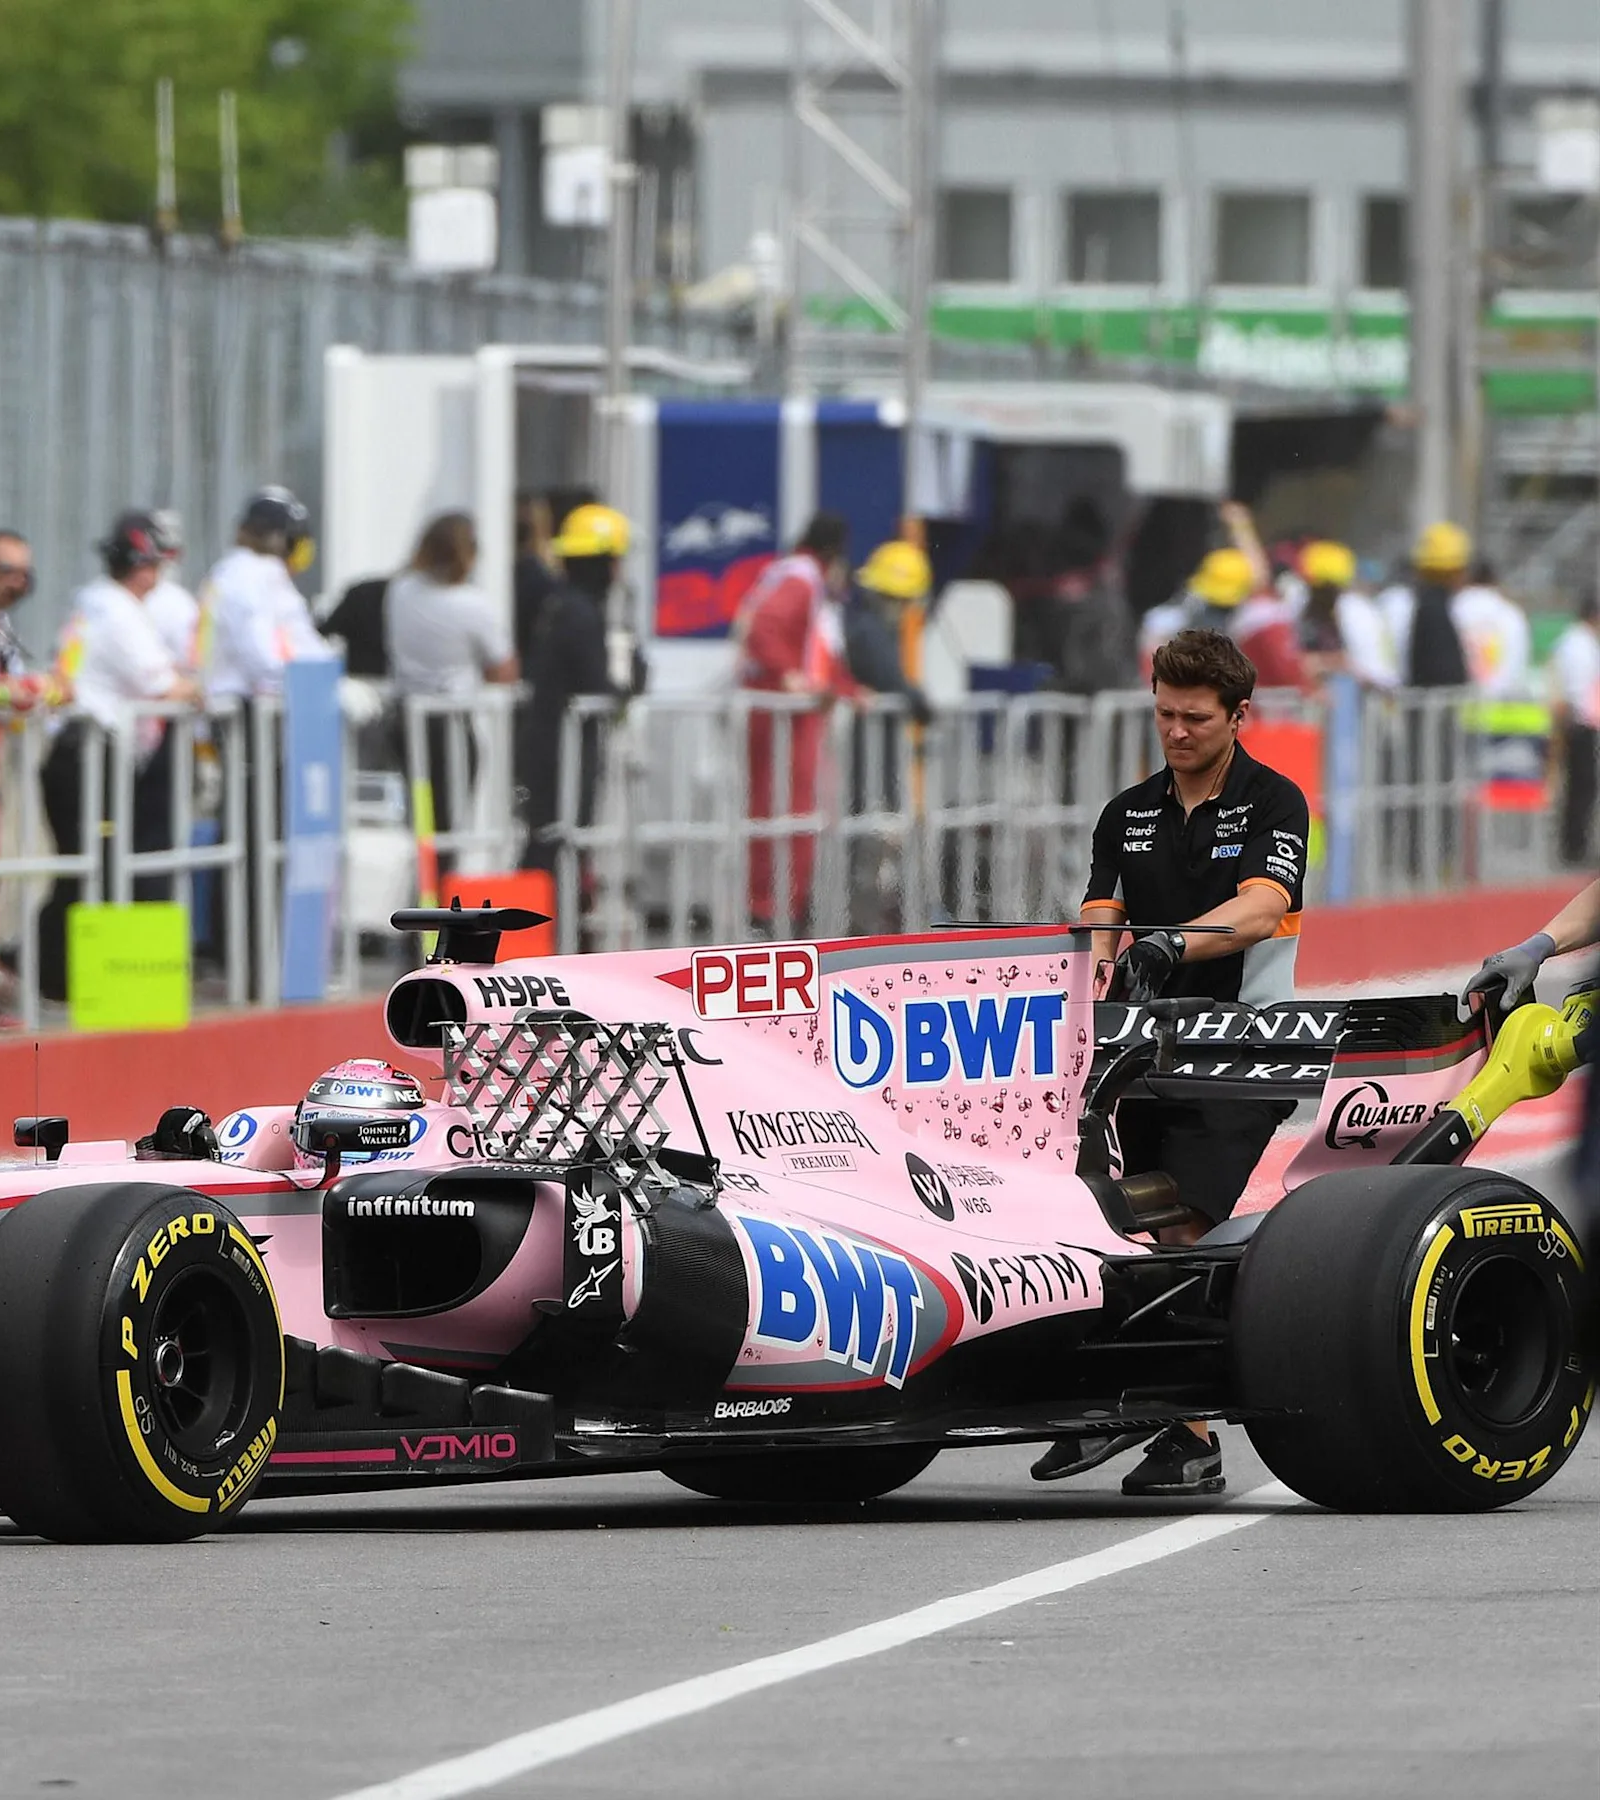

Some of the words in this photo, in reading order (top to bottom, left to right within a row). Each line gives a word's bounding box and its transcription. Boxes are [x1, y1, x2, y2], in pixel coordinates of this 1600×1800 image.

[1126, 823, 1157, 837] Claro
[1123, 841, 1153, 853] NEC
[473, 975, 571, 1008] HYPE
[695, 950, 814, 1016] PER
[905, 990, 1064, 1085] BWT
[309, 1082, 325, 1094] EC
[345, 1085, 384, 1097] BWT
[393, 1089, 422, 1103] NEC
[1346, 1103, 1427, 1128] QUAKER
[358, 1125, 398, 1137] JOHNNIE
[360, 1135, 398, 1145] WALKER
[726, 1109, 881, 1160] KINGFISHER
[790, 1154, 851, 1171] PREMIUM
[347, 1194, 476, 1219] infinitum
[959, 1196, 992, 1214] W66
[1459, 1202, 1546, 1239] PIRELLI
[1537, 1228, 1568, 1260] SP
[121, 1315, 138, 1361] P
[130, 1212, 216, 1304] ZERO
[988, 1251, 1090, 1308] FXTM
[737, 1214, 920, 1381] BWT
[714, 1397, 793, 1419] BARBADOS
[399, 1432, 518, 1462] VJM10
[1442, 1433, 1552, 1483] ZERO
[217, 1415, 278, 1513] PIRELLI
